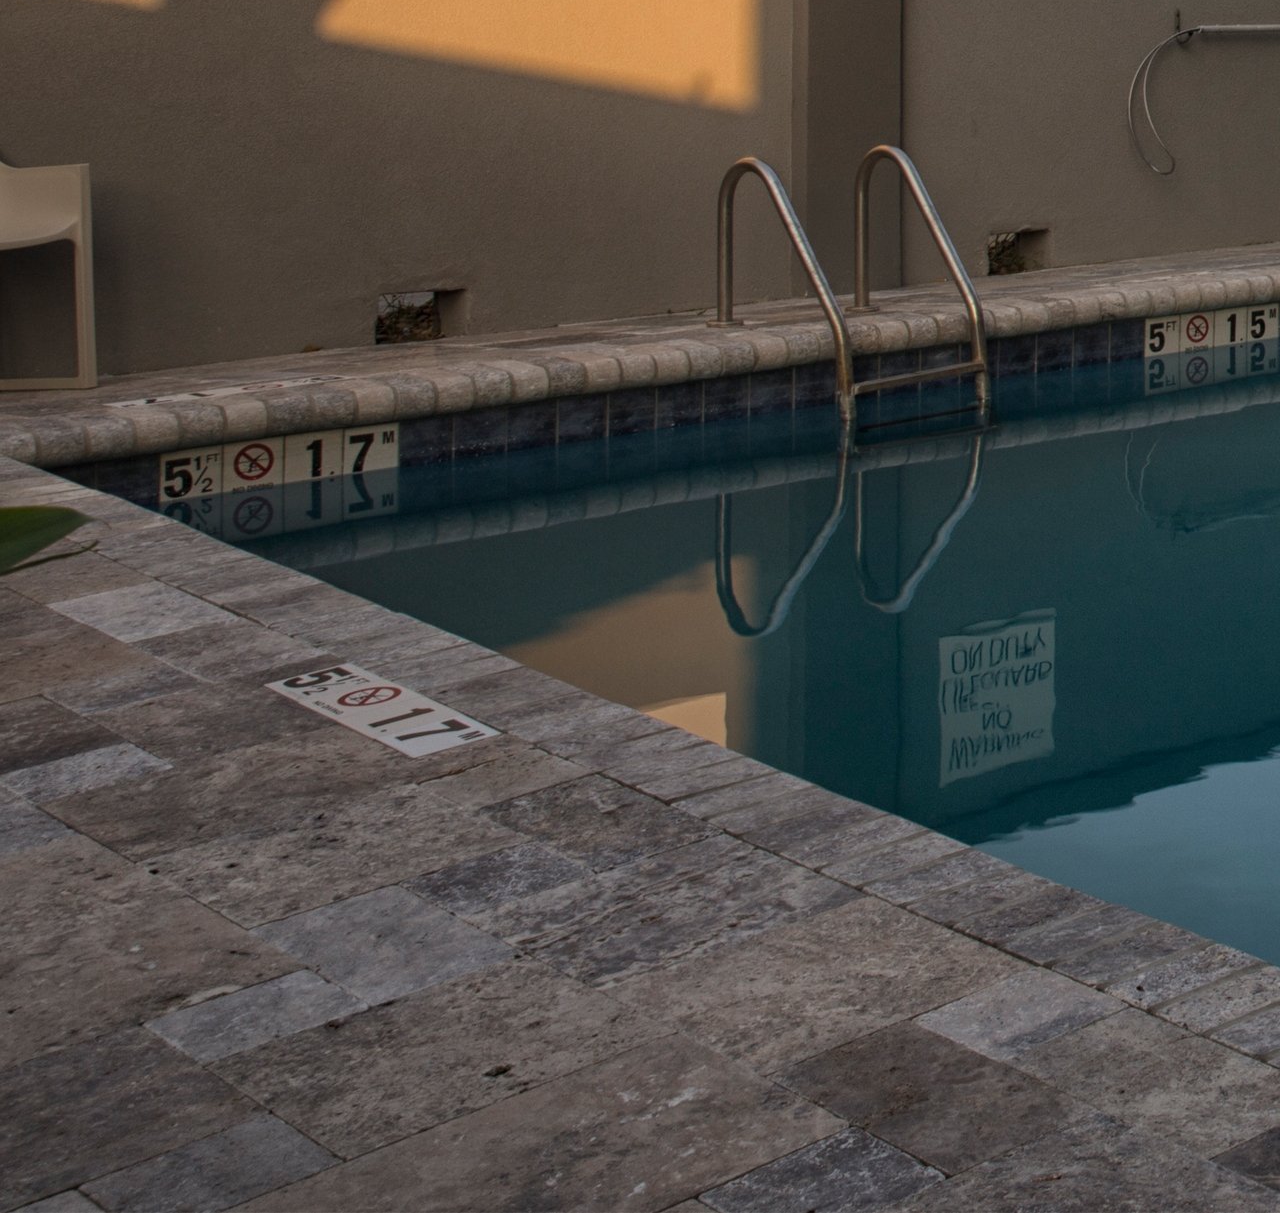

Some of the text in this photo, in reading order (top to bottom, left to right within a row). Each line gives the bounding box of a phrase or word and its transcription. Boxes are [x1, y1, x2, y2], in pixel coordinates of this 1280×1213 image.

[1149, 321, 1177, 352] 5 FT
[383, 431, 394, 444] M
[206, 453, 219, 463] FT
[457, 730, 486, 741] M
